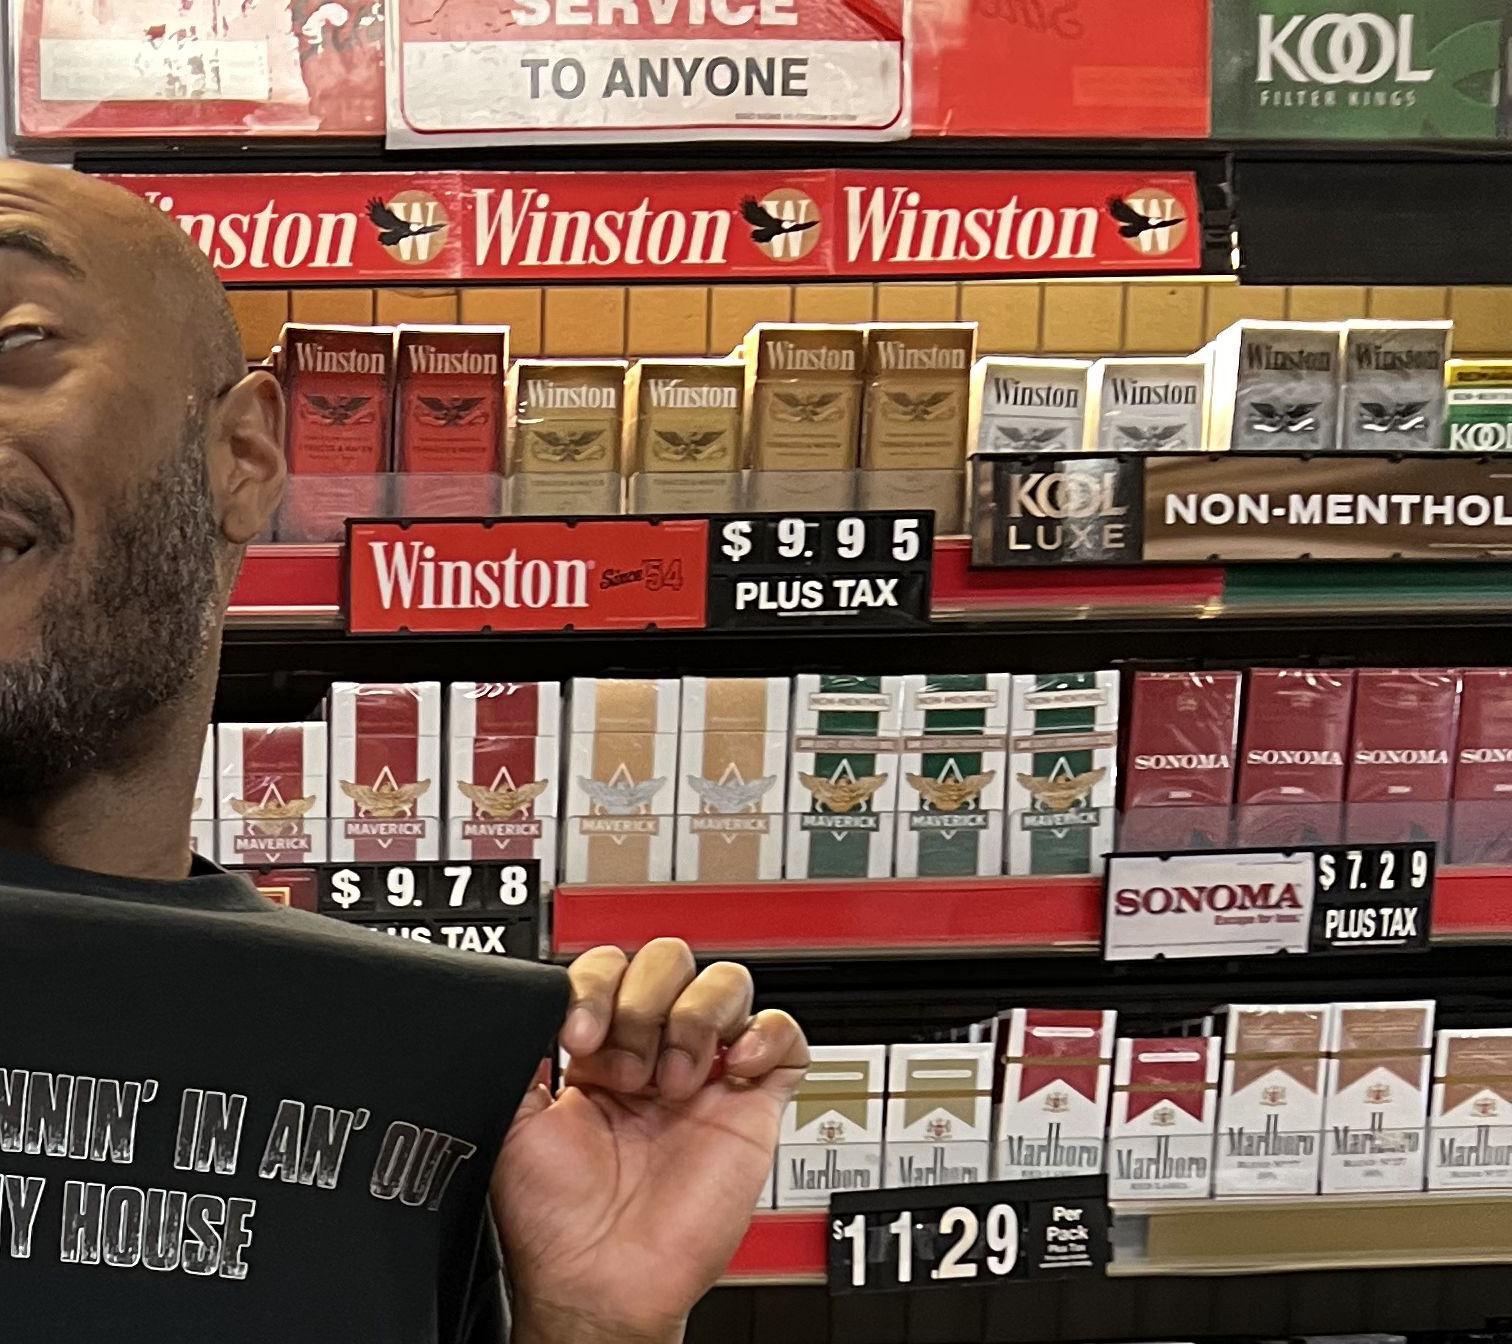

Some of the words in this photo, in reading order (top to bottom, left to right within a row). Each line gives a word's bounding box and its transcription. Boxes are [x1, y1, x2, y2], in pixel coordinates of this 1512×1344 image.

[1254, 12, 1434, 85] KOOL
[520, 58, 587, 100] TO
[600, 56, 808, 100] ANYONE
[1261, 89, 1337, 106] FILTER
[1348, 90, 1417, 108] KINGS
[469, 188, 732, 268] Winston
[842, 186, 1100, 262] Winston
[295, 342, 385, 377] Winston
[527, 379, 616, 410] Winston
[1008, 471, 1128, 519] KOOL
[1008, 523, 1126, 553] LUXE
[369, 541, 590, 611] Winston
[735, 581, 824, 612] PLUS
[834, 579, 898, 607] TAX
[1135, 755, 1230, 771] SONOMA
[345, 822, 423, 838] MAVERICK
[1114, 882, 1302, 916] SONOMA
[442, 926, 506, 954] TAX
[1325, 910, 1375, 939] PLUS
[1380, 908, 1418, 936] TAX
[173, 1088, 247, 1175] IN
[259, 1098, 370, 1189] AN'
[369, 1121, 476, 1211] OUT
[1006, 1122, 1098, 1169] Marlboro
[60, 1180, 256, 1281] HOUSE
[1053, 1206, 1083, 1222] Per
[1046, 1225, 1089, 1242] Pack
